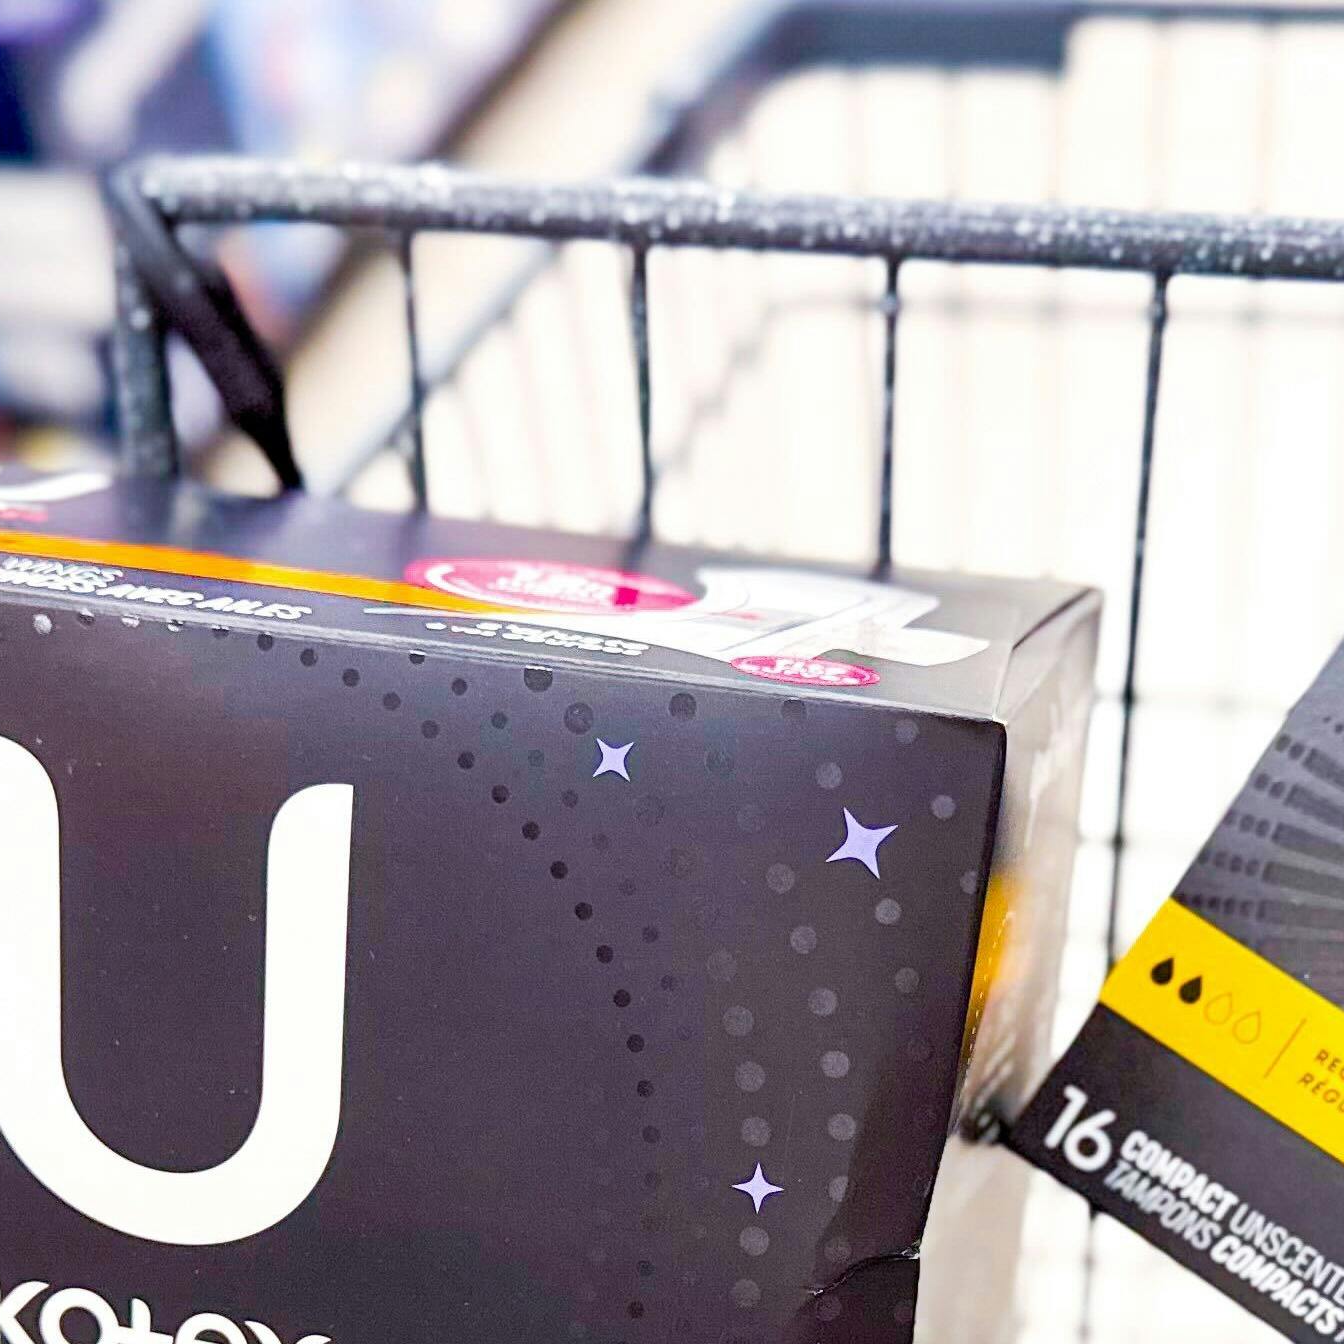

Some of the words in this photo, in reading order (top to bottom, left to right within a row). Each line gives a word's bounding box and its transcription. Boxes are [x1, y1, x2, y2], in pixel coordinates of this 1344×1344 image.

[198, 597, 313, 621] AILES
[1043, 1084, 1117, 1173] 16
[1103, 1158, 1222, 1251] TAMPONS
[1120, 1129, 1239, 1222] COMPACT
